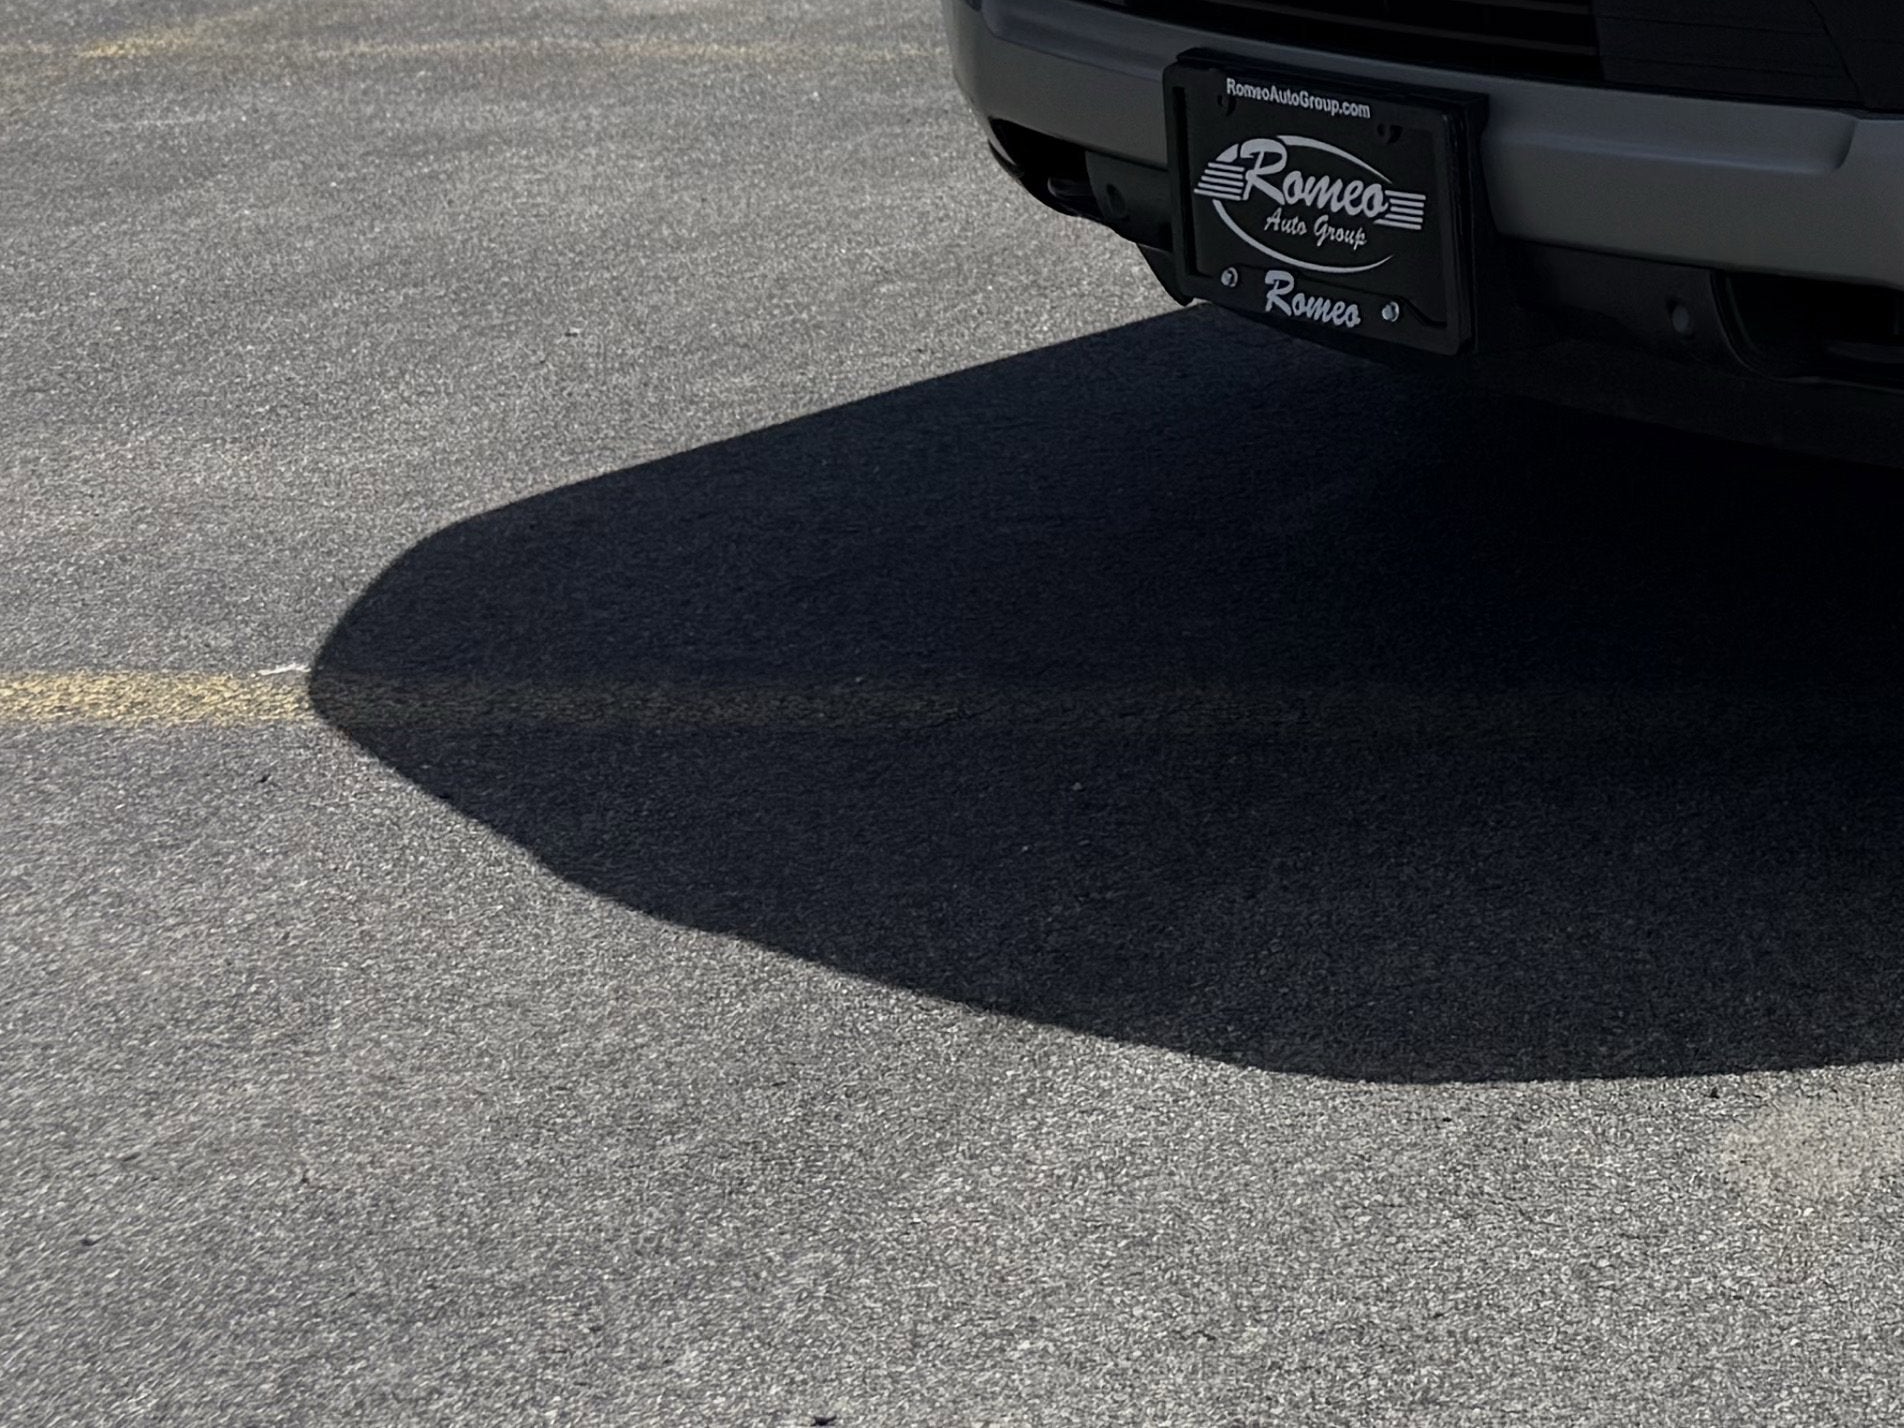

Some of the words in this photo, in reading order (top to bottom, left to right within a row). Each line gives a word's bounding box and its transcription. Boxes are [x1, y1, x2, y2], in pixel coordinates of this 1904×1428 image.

[1225, 77, 1371, 119] RomeoAutoGroup.com
[1239, 137, 1389, 218] Romeo
[1263, 207, 1308, 236] Auto
[1313, 213, 1368, 250] Group
[1264, 269, 1362, 328] Romeo
